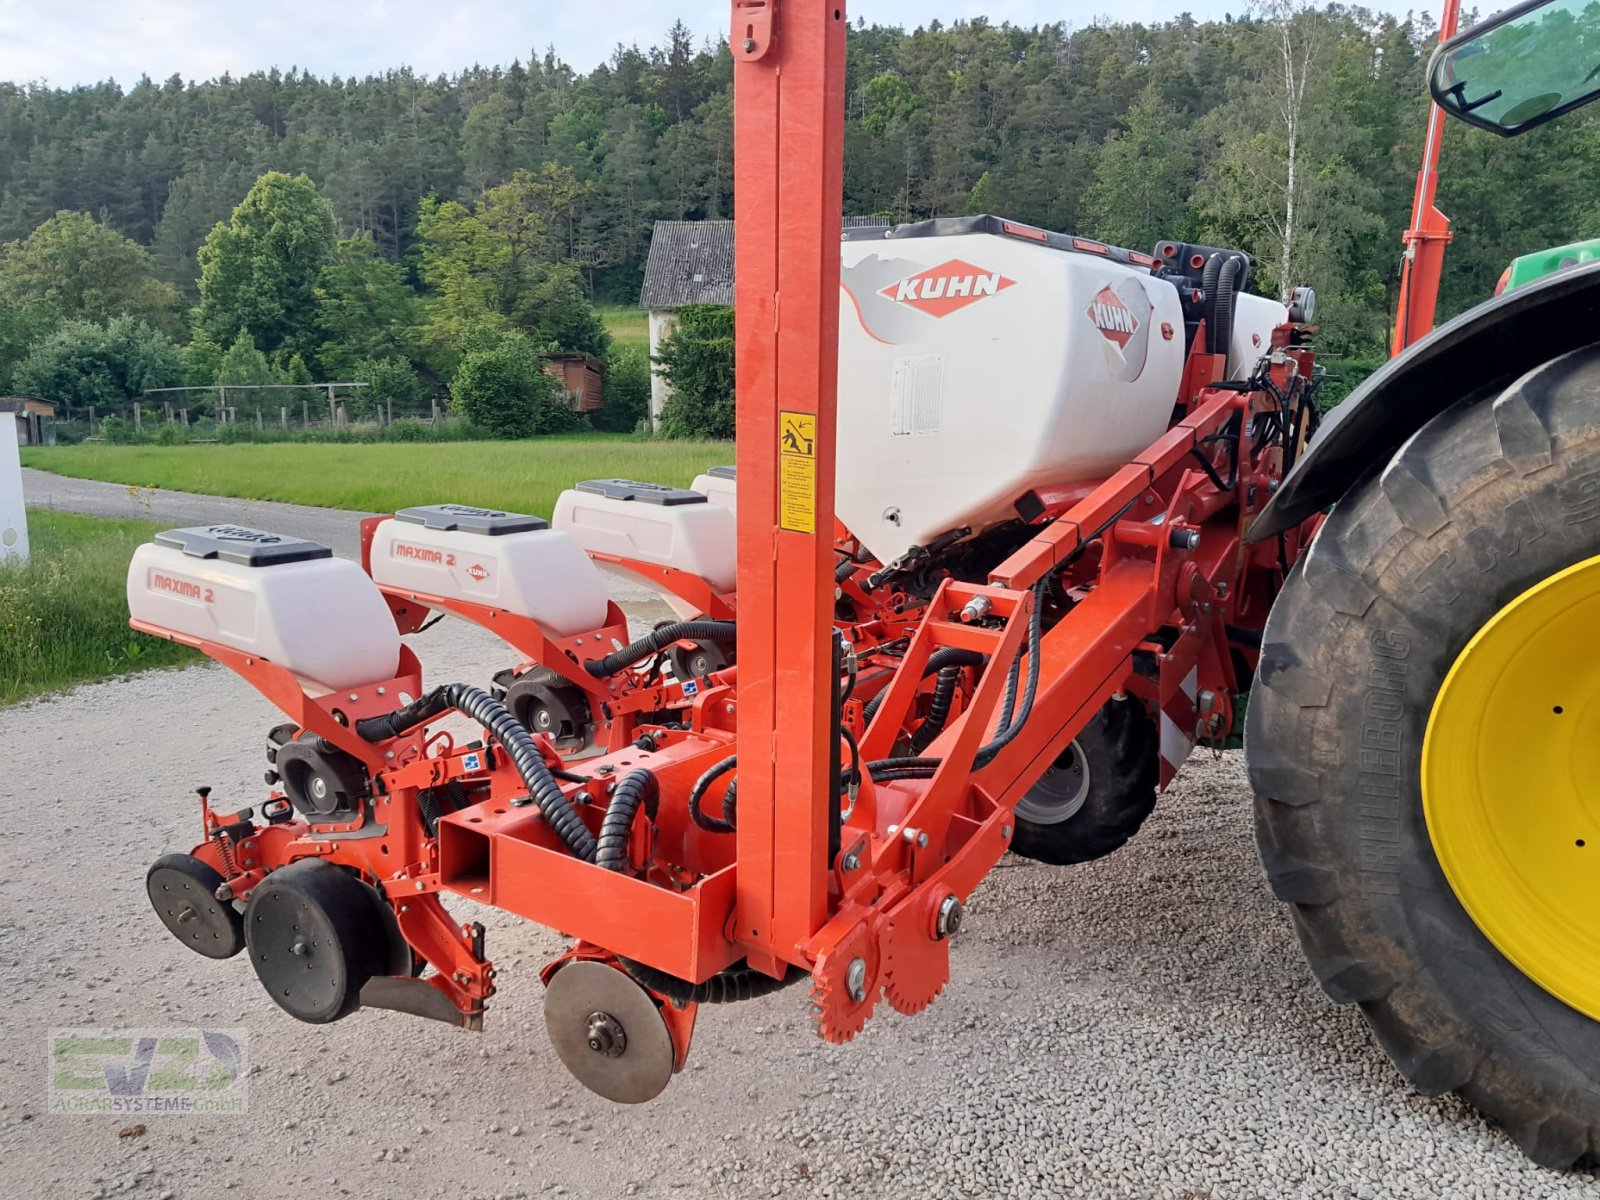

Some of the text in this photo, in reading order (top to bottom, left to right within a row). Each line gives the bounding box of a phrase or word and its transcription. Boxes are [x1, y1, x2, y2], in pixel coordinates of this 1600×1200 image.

[895, 273, 1001, 302] KUHN
[1092, 302, 1135, 335] KUHN
[396, 543, 456, 566] MAXIMA 2
[468, 567, 488, 579] KUHN
[154, 574, 215, 604] MAXIMA 2
